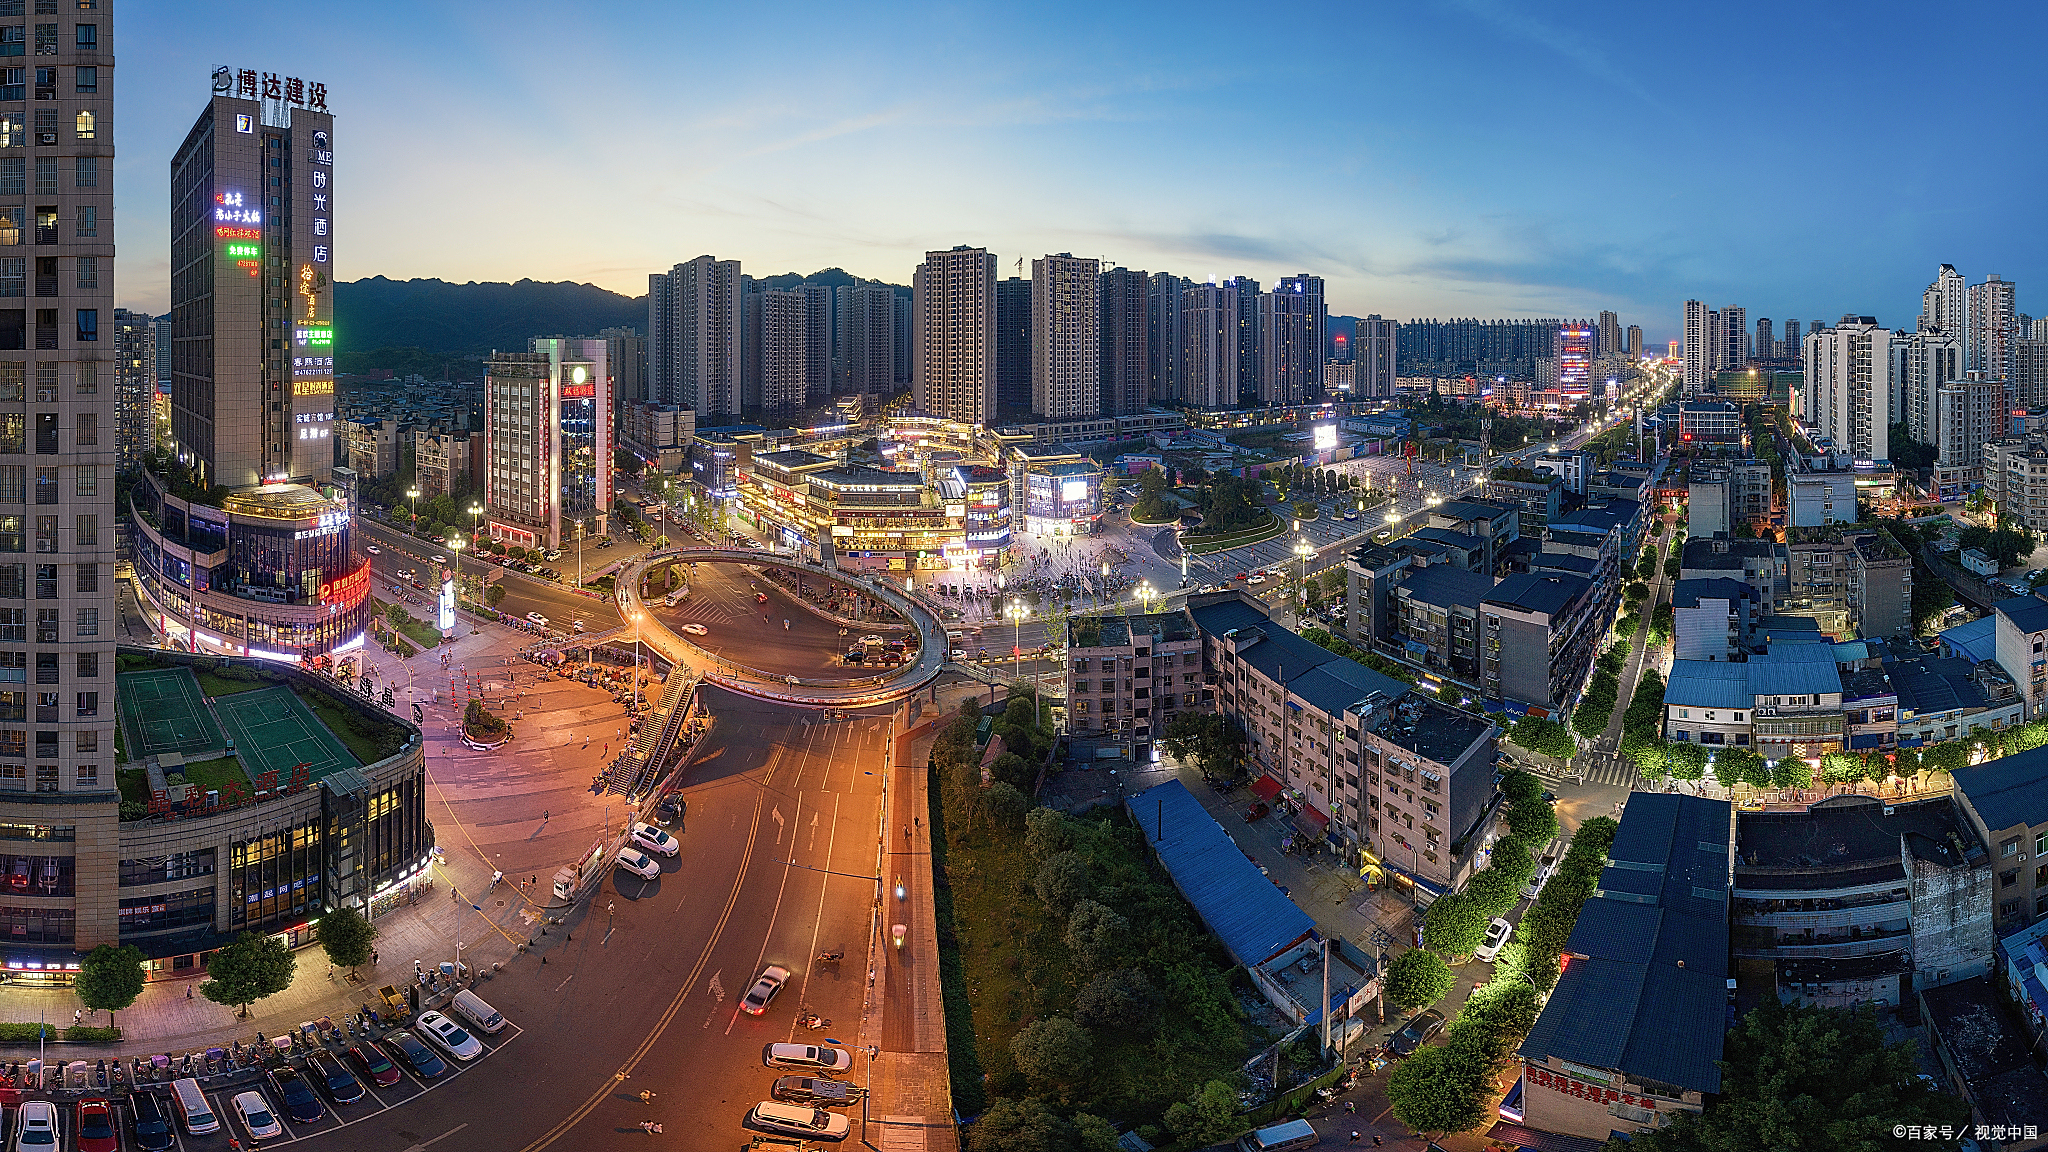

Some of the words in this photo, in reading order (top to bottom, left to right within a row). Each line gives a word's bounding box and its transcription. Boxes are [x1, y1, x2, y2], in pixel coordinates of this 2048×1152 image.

[237, 68, 328, 109] 博达建设
[1506, 707, 1525, 717] vivo
[148, 762, 312, 814] 晶彩大酒店
[1526, 1066, 1655, 1109] 自动挡变速箱专修
